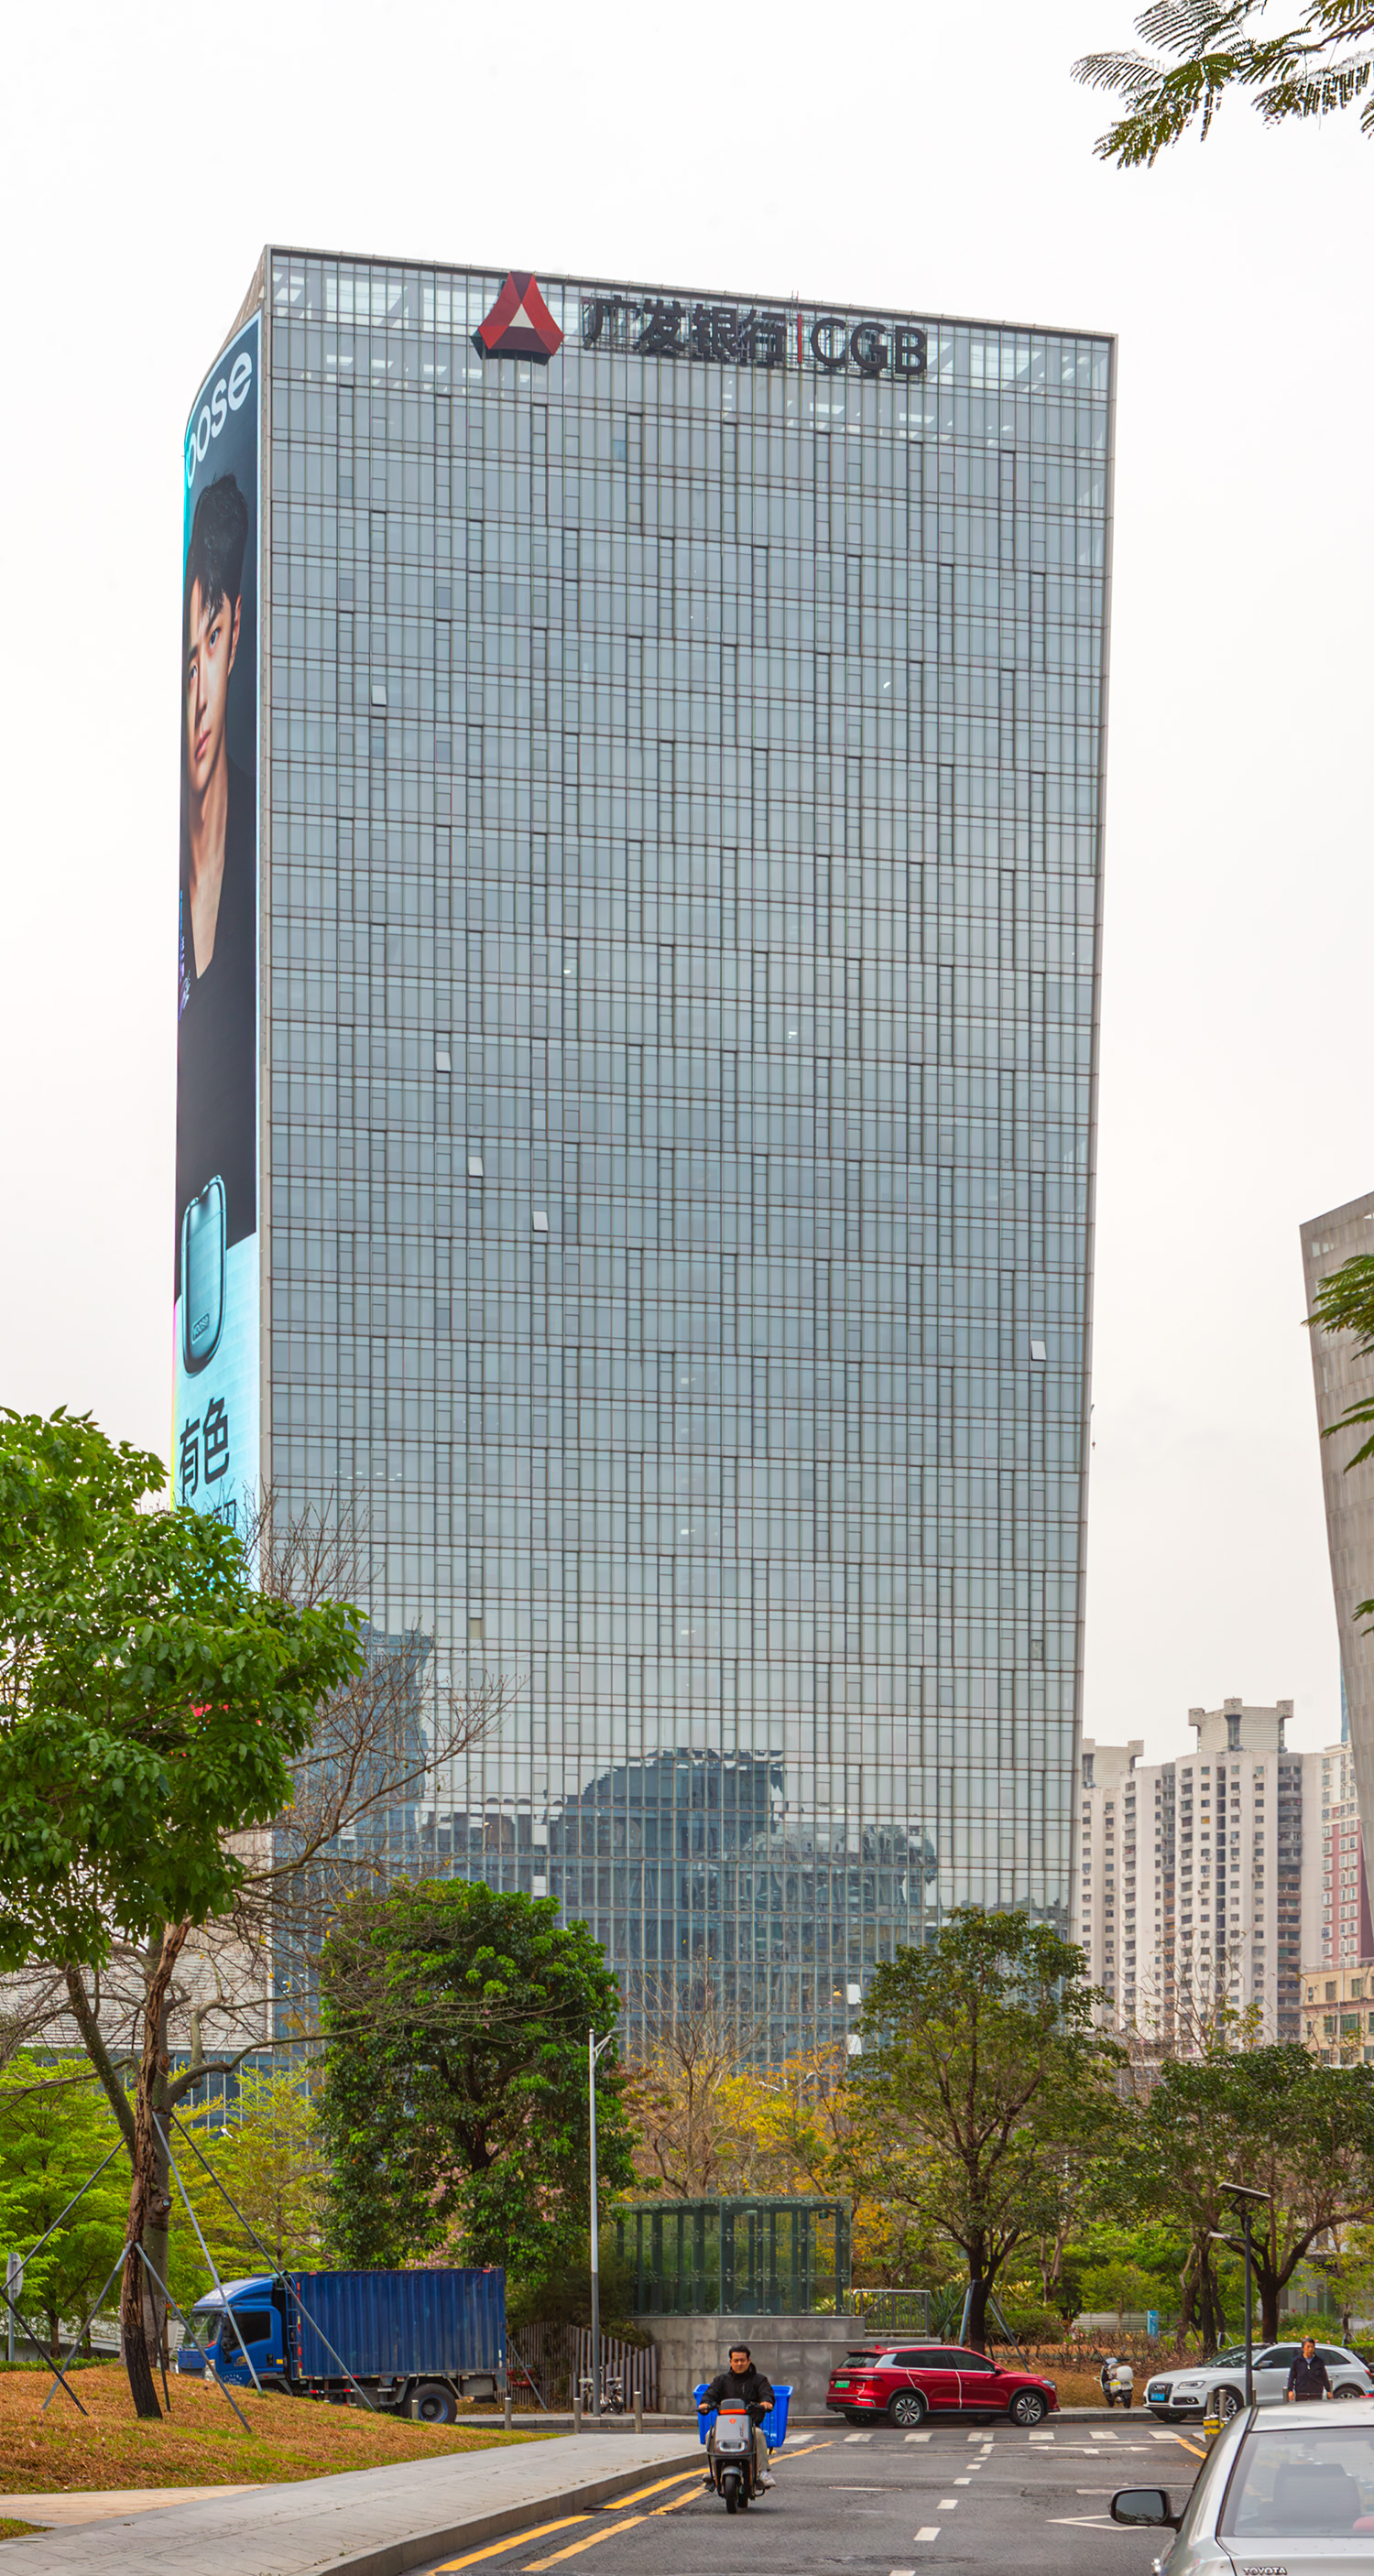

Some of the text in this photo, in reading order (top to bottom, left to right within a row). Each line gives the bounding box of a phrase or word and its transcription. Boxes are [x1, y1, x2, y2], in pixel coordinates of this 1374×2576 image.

[586, 295, 927, 375] 广发银行 CGB
[180, 1397, 230, 1504] 有色
[1243, 2567, 1287, 2576] TOYOTA
